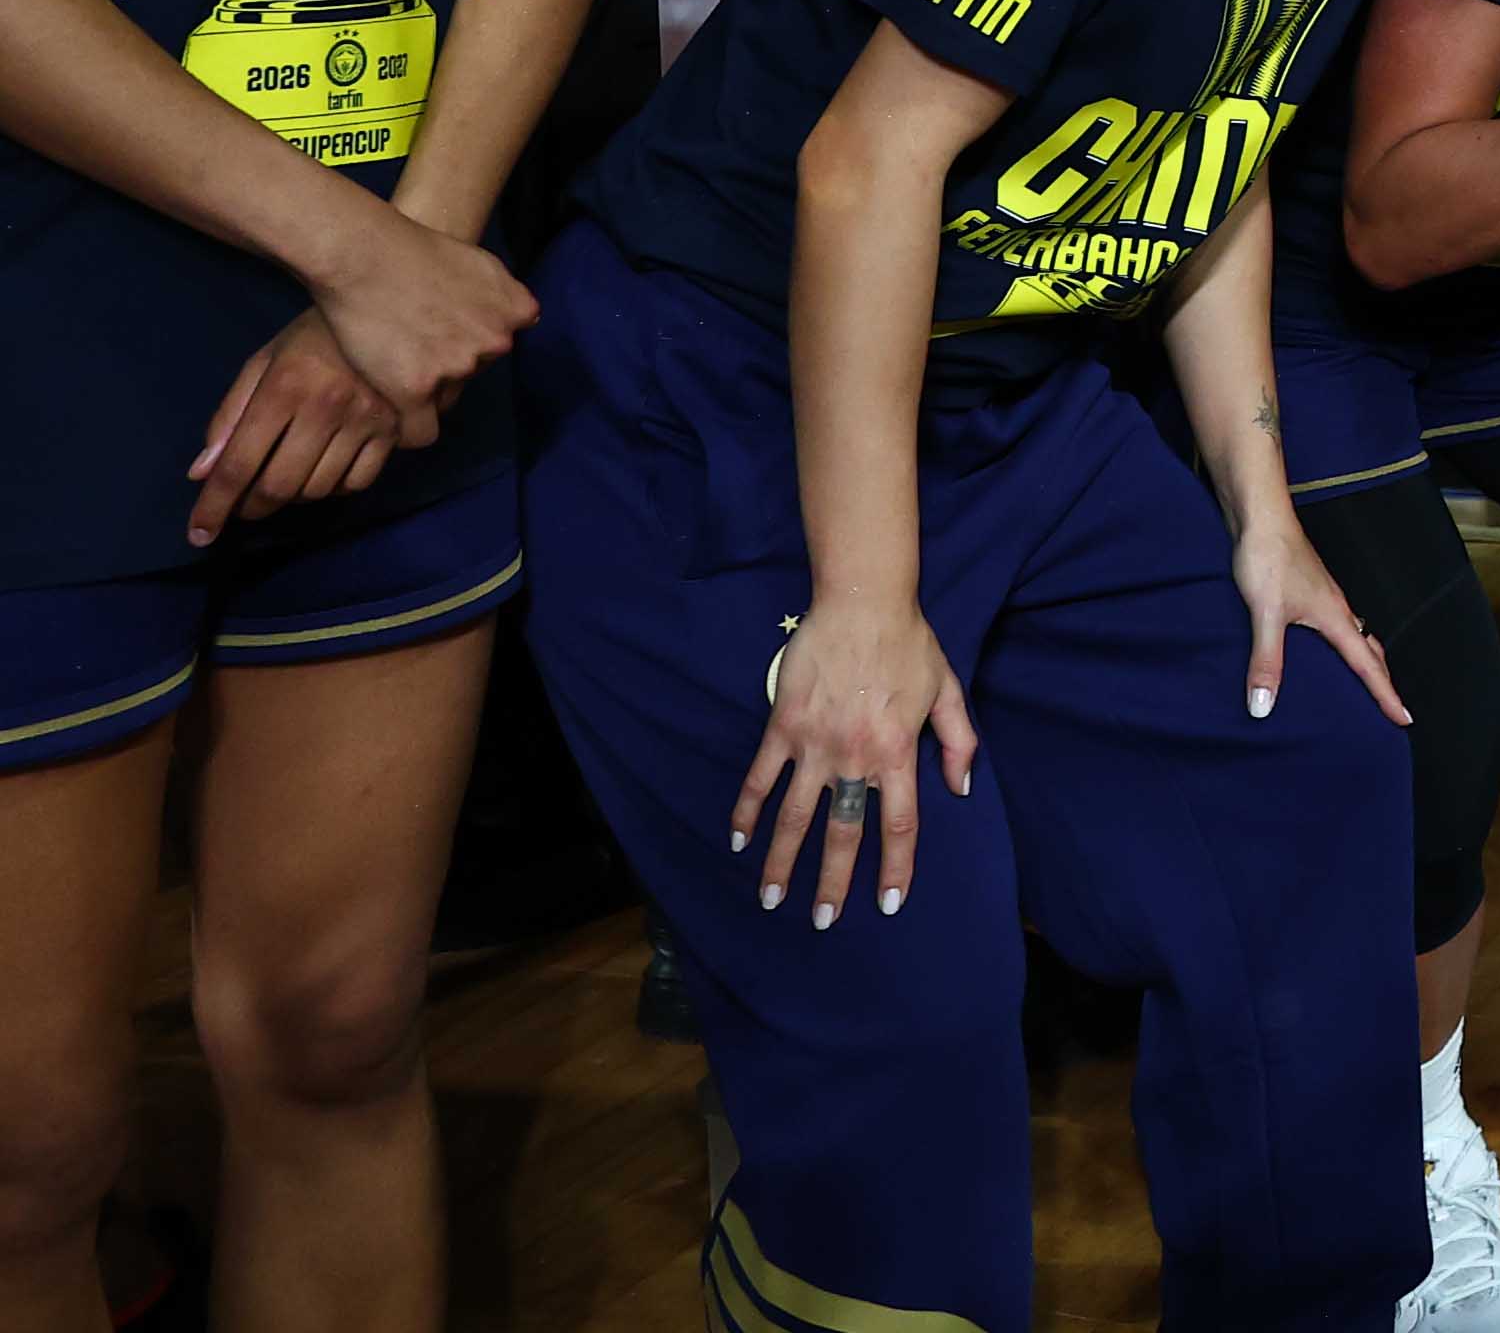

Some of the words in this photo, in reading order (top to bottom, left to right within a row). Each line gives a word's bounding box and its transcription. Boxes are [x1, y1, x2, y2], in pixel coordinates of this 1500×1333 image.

[247, 64, 311, 92] 2026
[378, 53, 409, 80] 2027
[327, 89, 363, 111] tarfin
